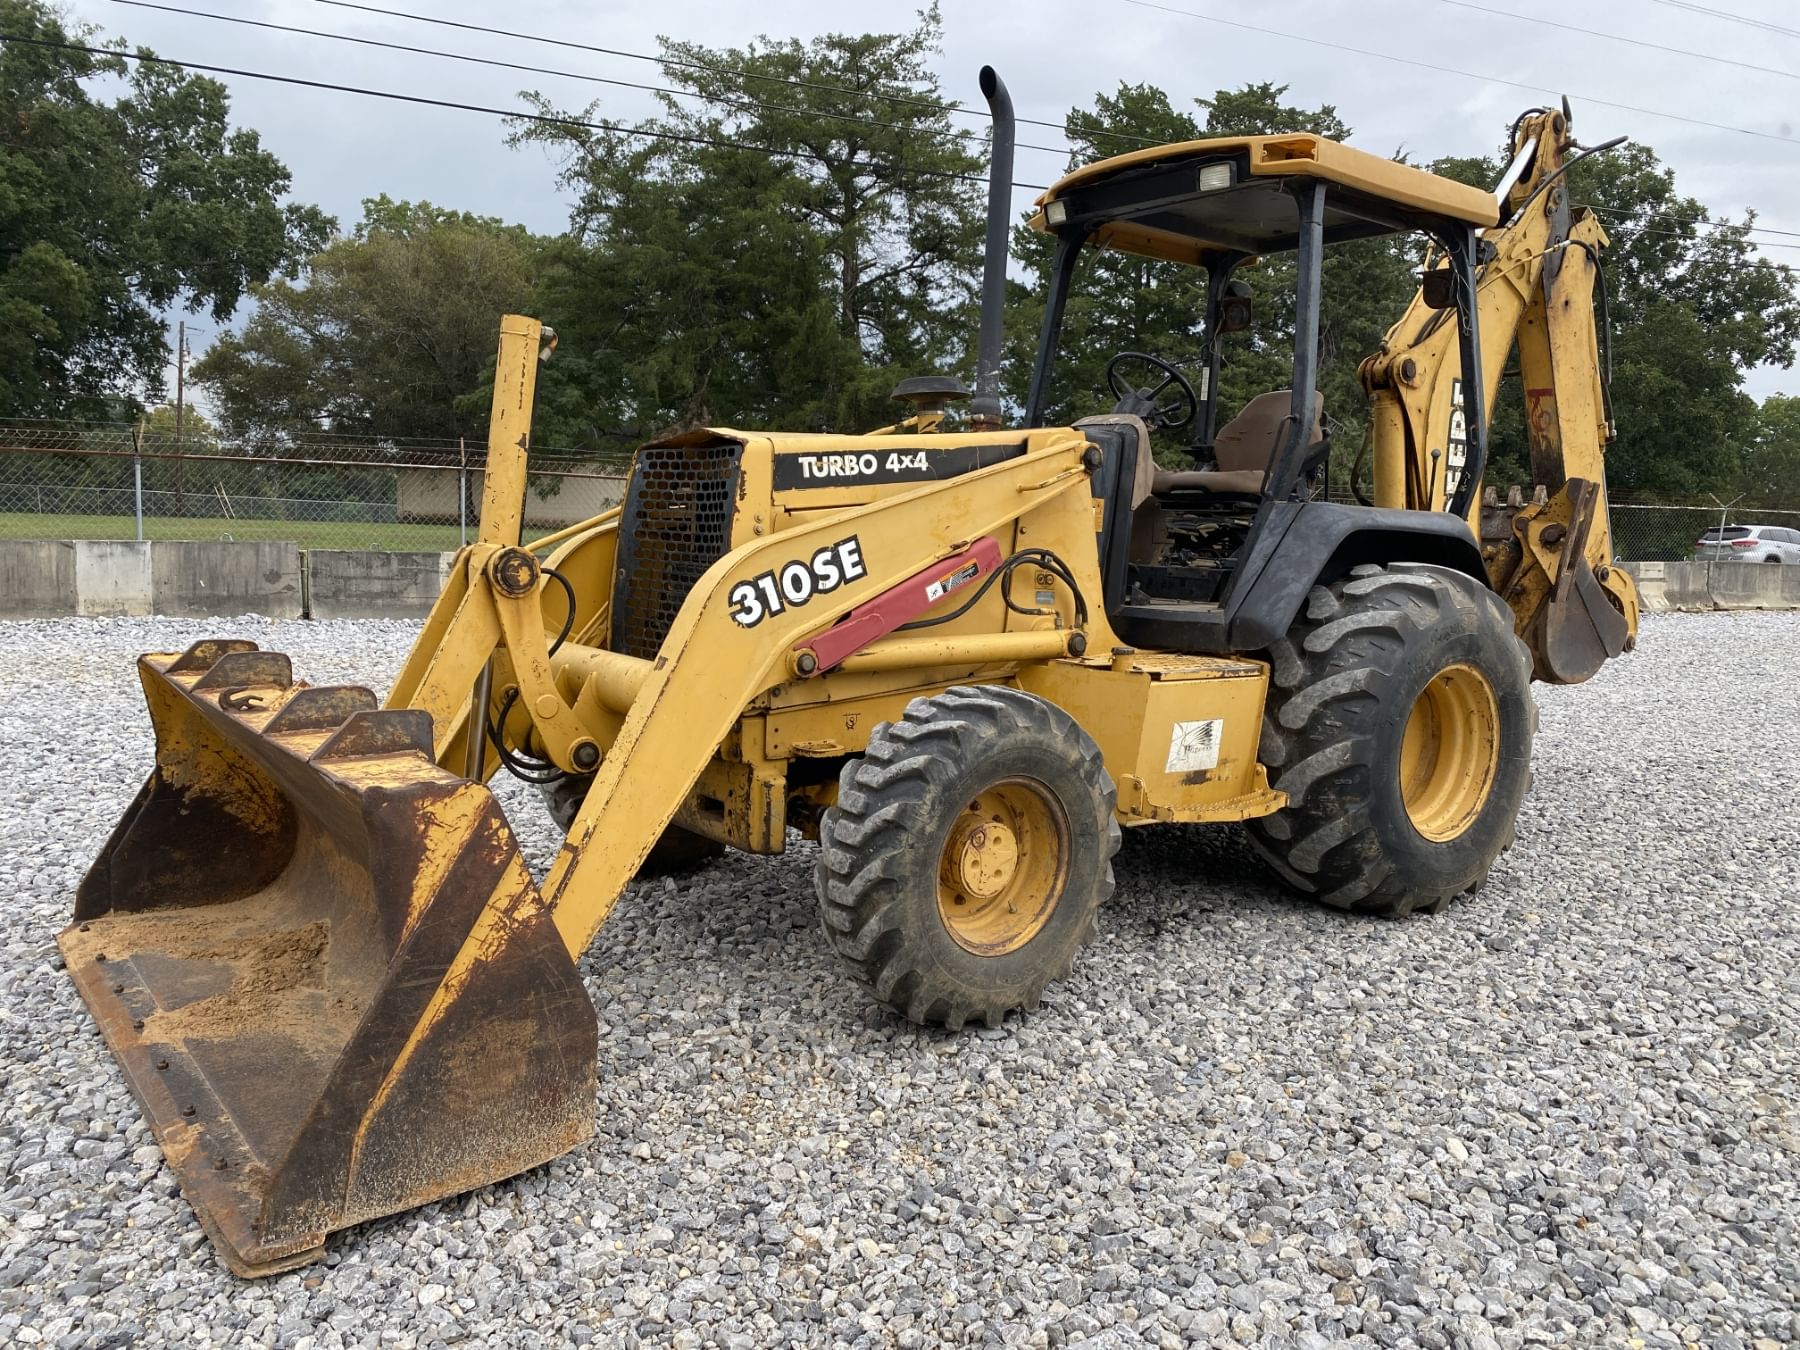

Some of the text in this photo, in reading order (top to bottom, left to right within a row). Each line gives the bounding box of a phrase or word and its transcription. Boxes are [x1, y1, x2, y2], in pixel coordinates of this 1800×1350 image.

[798, 451, 929, 478] TURBO 4x4
[1443, 378, 1467, 513] EER
[729, 536, 866, 627] 310SE
